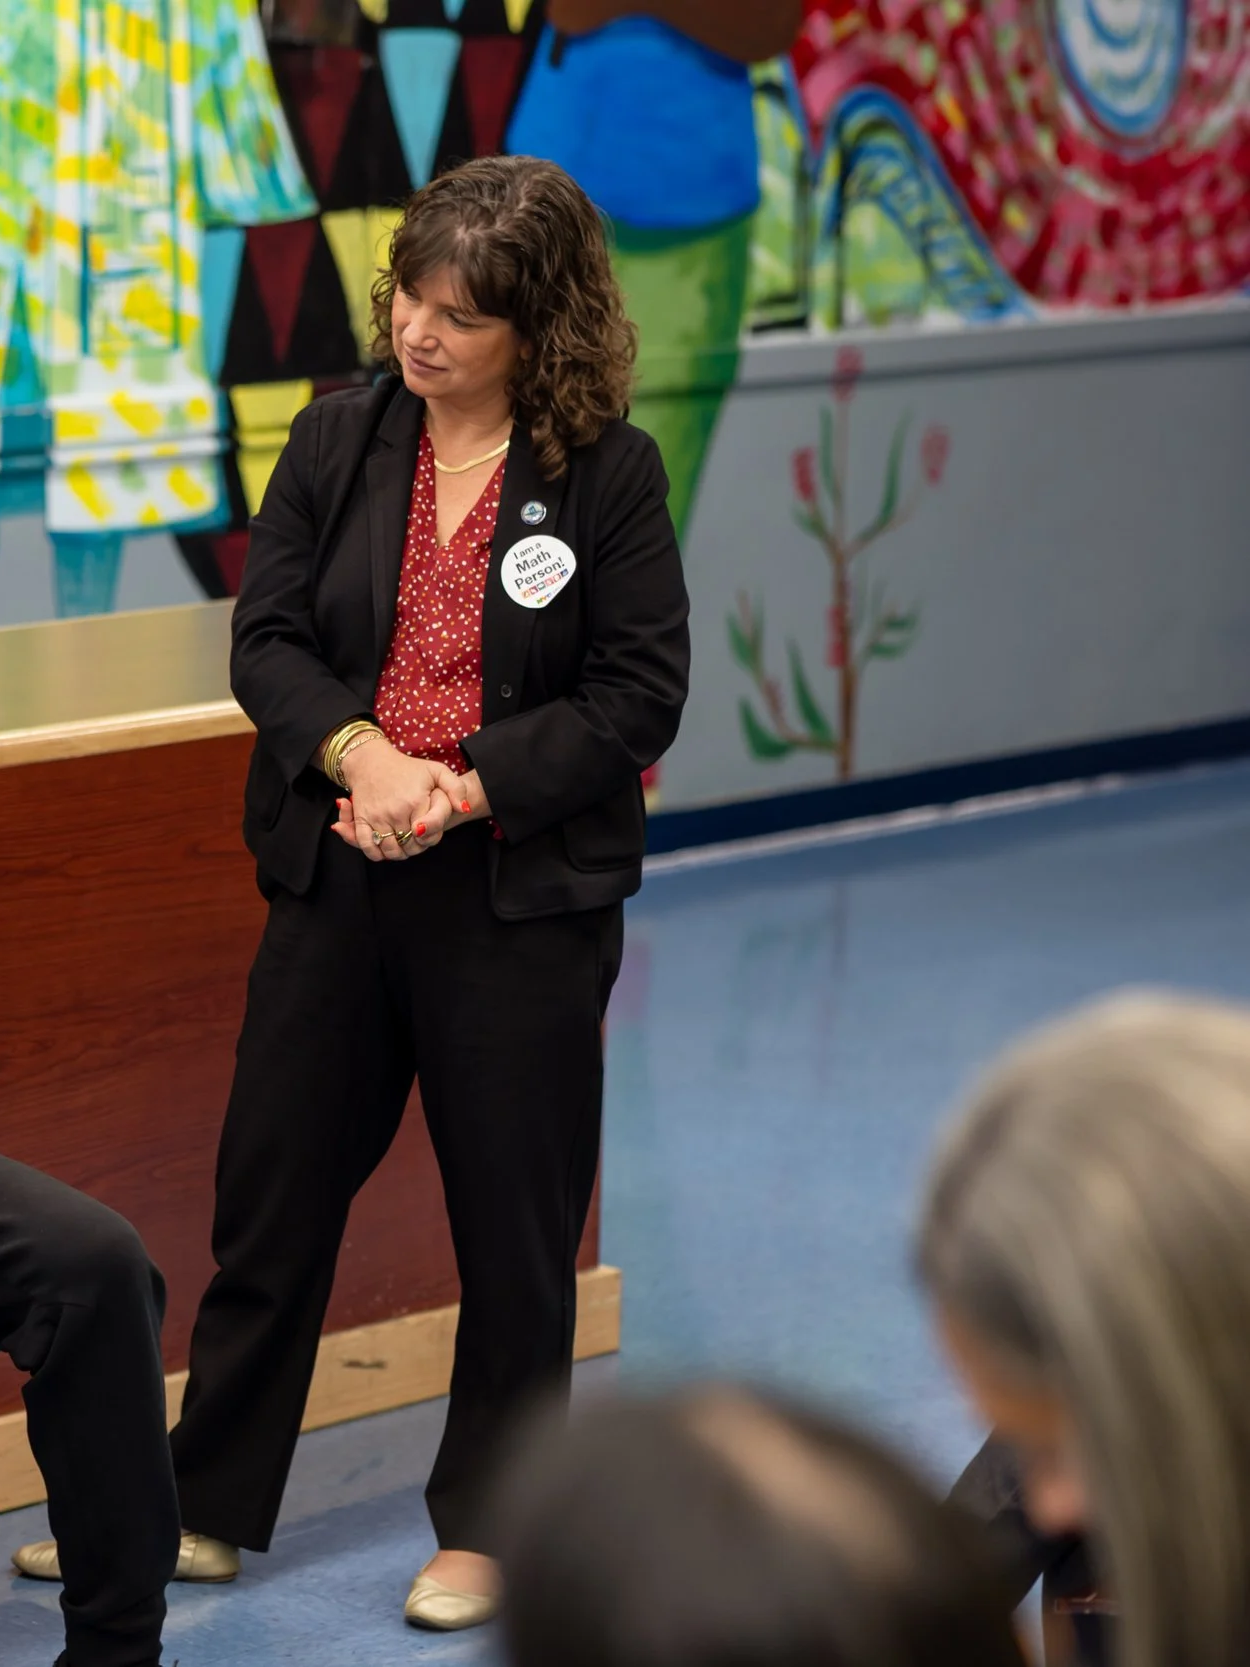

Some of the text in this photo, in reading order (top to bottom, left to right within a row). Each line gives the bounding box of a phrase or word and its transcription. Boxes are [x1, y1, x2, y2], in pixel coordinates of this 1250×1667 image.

[513, 551, 519, 560] I
[519, 546, 535, 558] am
[515, 550, 552, 574] Math
[514, 556, 565, 590] Person!
